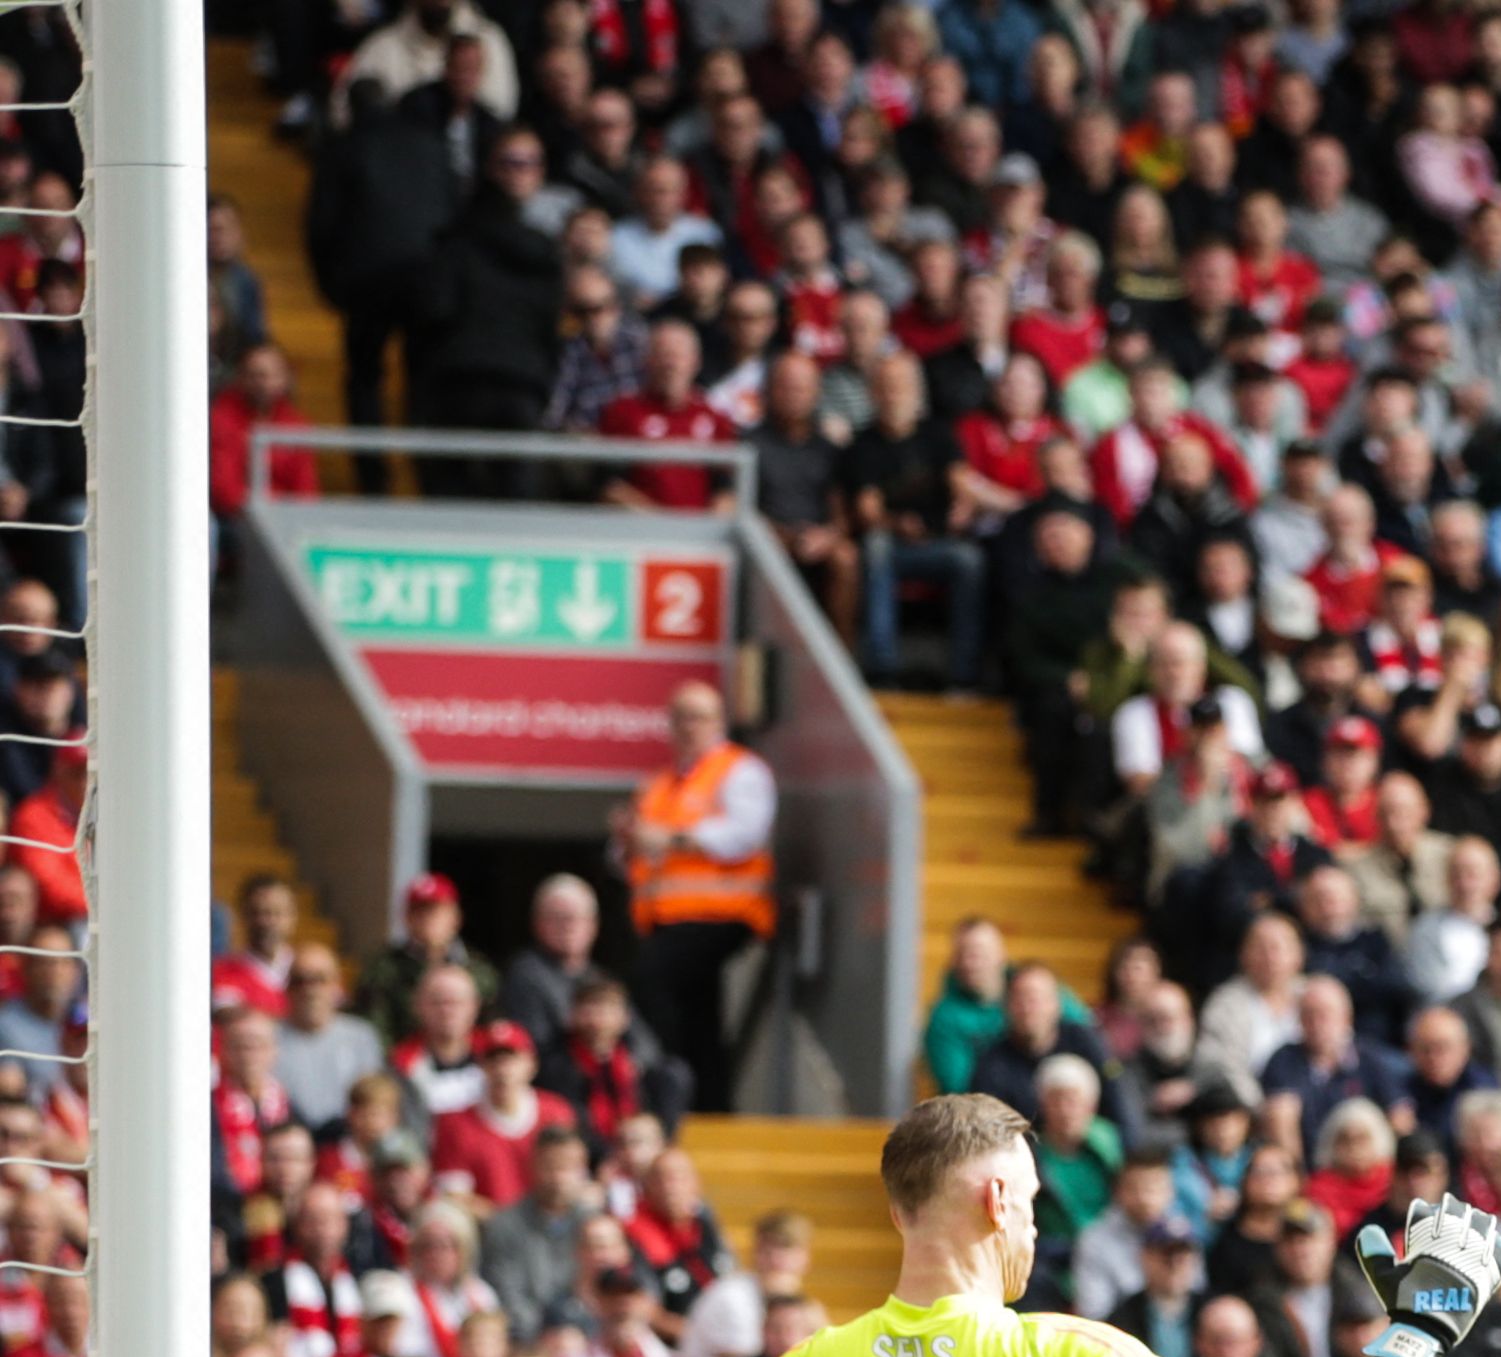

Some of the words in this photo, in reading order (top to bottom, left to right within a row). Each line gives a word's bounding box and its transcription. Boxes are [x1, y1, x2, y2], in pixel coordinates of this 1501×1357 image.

[321, 558, 471, 624] EXIT
[656, 571, 702, 635] 2
[1413, 1287, 1473, 1314] REAL
